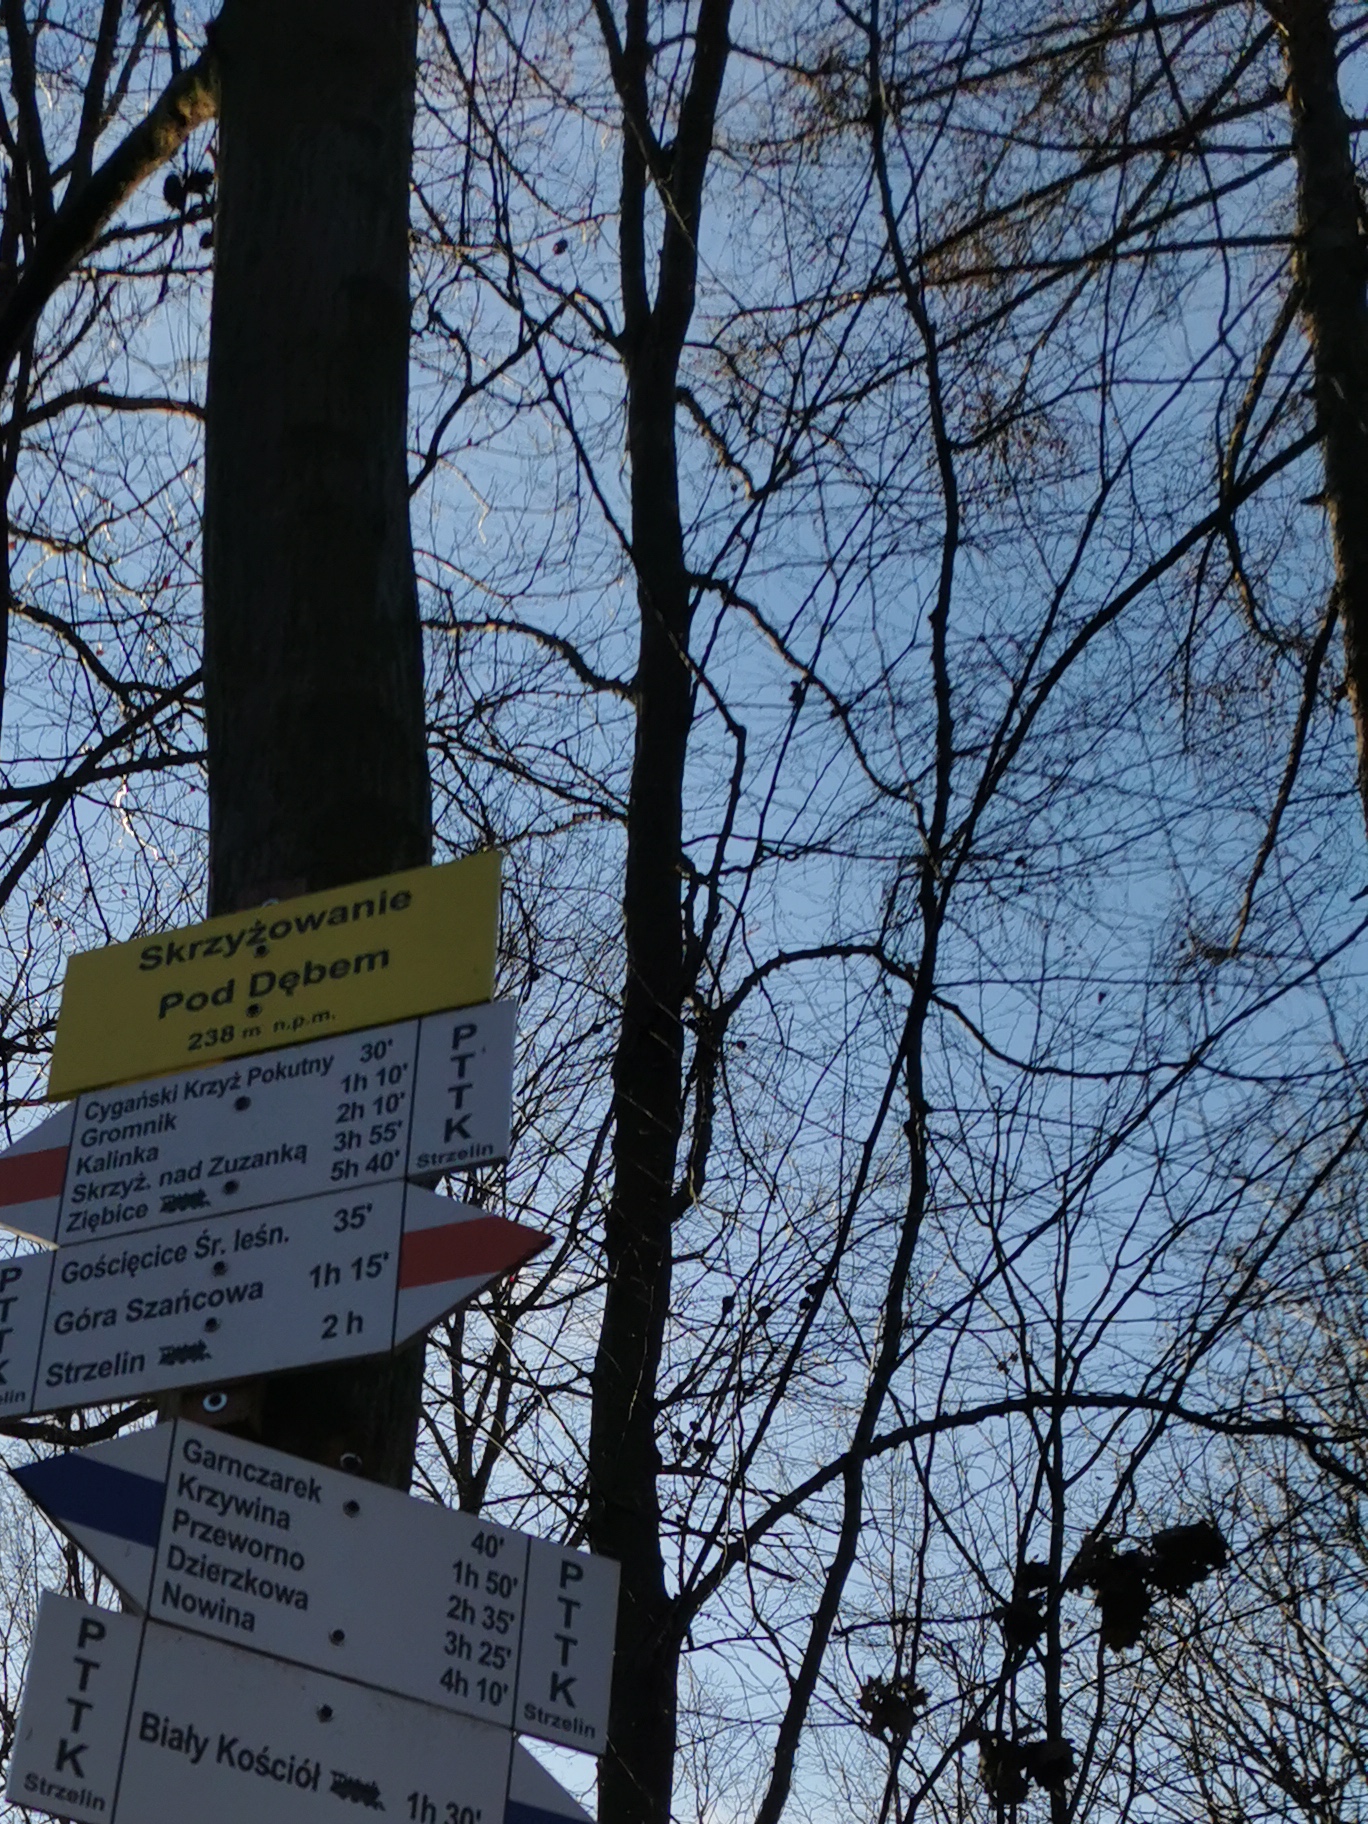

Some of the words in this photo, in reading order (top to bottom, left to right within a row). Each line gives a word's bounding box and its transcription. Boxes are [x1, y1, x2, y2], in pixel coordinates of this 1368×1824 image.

[138, 887, 413, 973] Skrzyżowanie
[158, 979, 235, 1020] Pod
[248, 946, 390, 998] Dębem
[188, 1025, 236, 1051] 238
[243, 1026, 262, 1039] m
[81, 1112, 177, 1148] Gromnik
[341, 1073, 367, 1094] 1h
[85, 1084, 178, 1124] Cygański
[184, 1072, 241, 1100] Krzyż
[247, 1054, 334, 1087] Pokutny
[444, 1023, 477, 1144] PTTK
[71, 1171, 150, 1204] Skrzyż.
[158, 1161, 202, 1187] nad
[208, 1143, 307, 1178] Zuzanką
[334, 1130, 361, 1152] 3h
[76, 1145, 159, 1177] Kalinka
[335, 1102, 364, 1124] 2h
[416, 1143, 494, 1169] Strzelin
[66, 1203, 149, 1233] Ziębice
[330, 1159, 359, 1182] 5h
[61, 1244, 188, 1285] Gościęcice
[194, 1229, 226, 1259] Śr.
[233, 1222, 290, 1253] leśn.
[54, 1306, 117, 1335] Góra
[125, 1280, 264, 1322] Szańcowa
[309, 1263, 341, 1289] 1h
[45, 1351, 146, 1388] Strzelin
[183, 1438, 323, 1504] Garnczarek
[171, 1507, 305, 1572] Przeworno
[446, 1594, 476, 1626] 2h
[177, 1472, 290, 1531] Krzywina
[452, 1560, 479, 1590] 1h
[161, 1580, 256, 1633] Nowina
[439, 1666, 469, 1698] 4h
[166, 1544, 309, 1612] Dzierzkowa
[443, 1630, 473, 1661] 3h
[549, 1560, 583, 1709] PTTK
[54, 1617, 107, 1779] PTTK
[523, 1702, 597, 1740] Strzelin
[139, 1710, 209, 1765] Biały
[216, 1733, 321, 1791] Kościół
[23, 1772, 106, 1812] Strzelin
